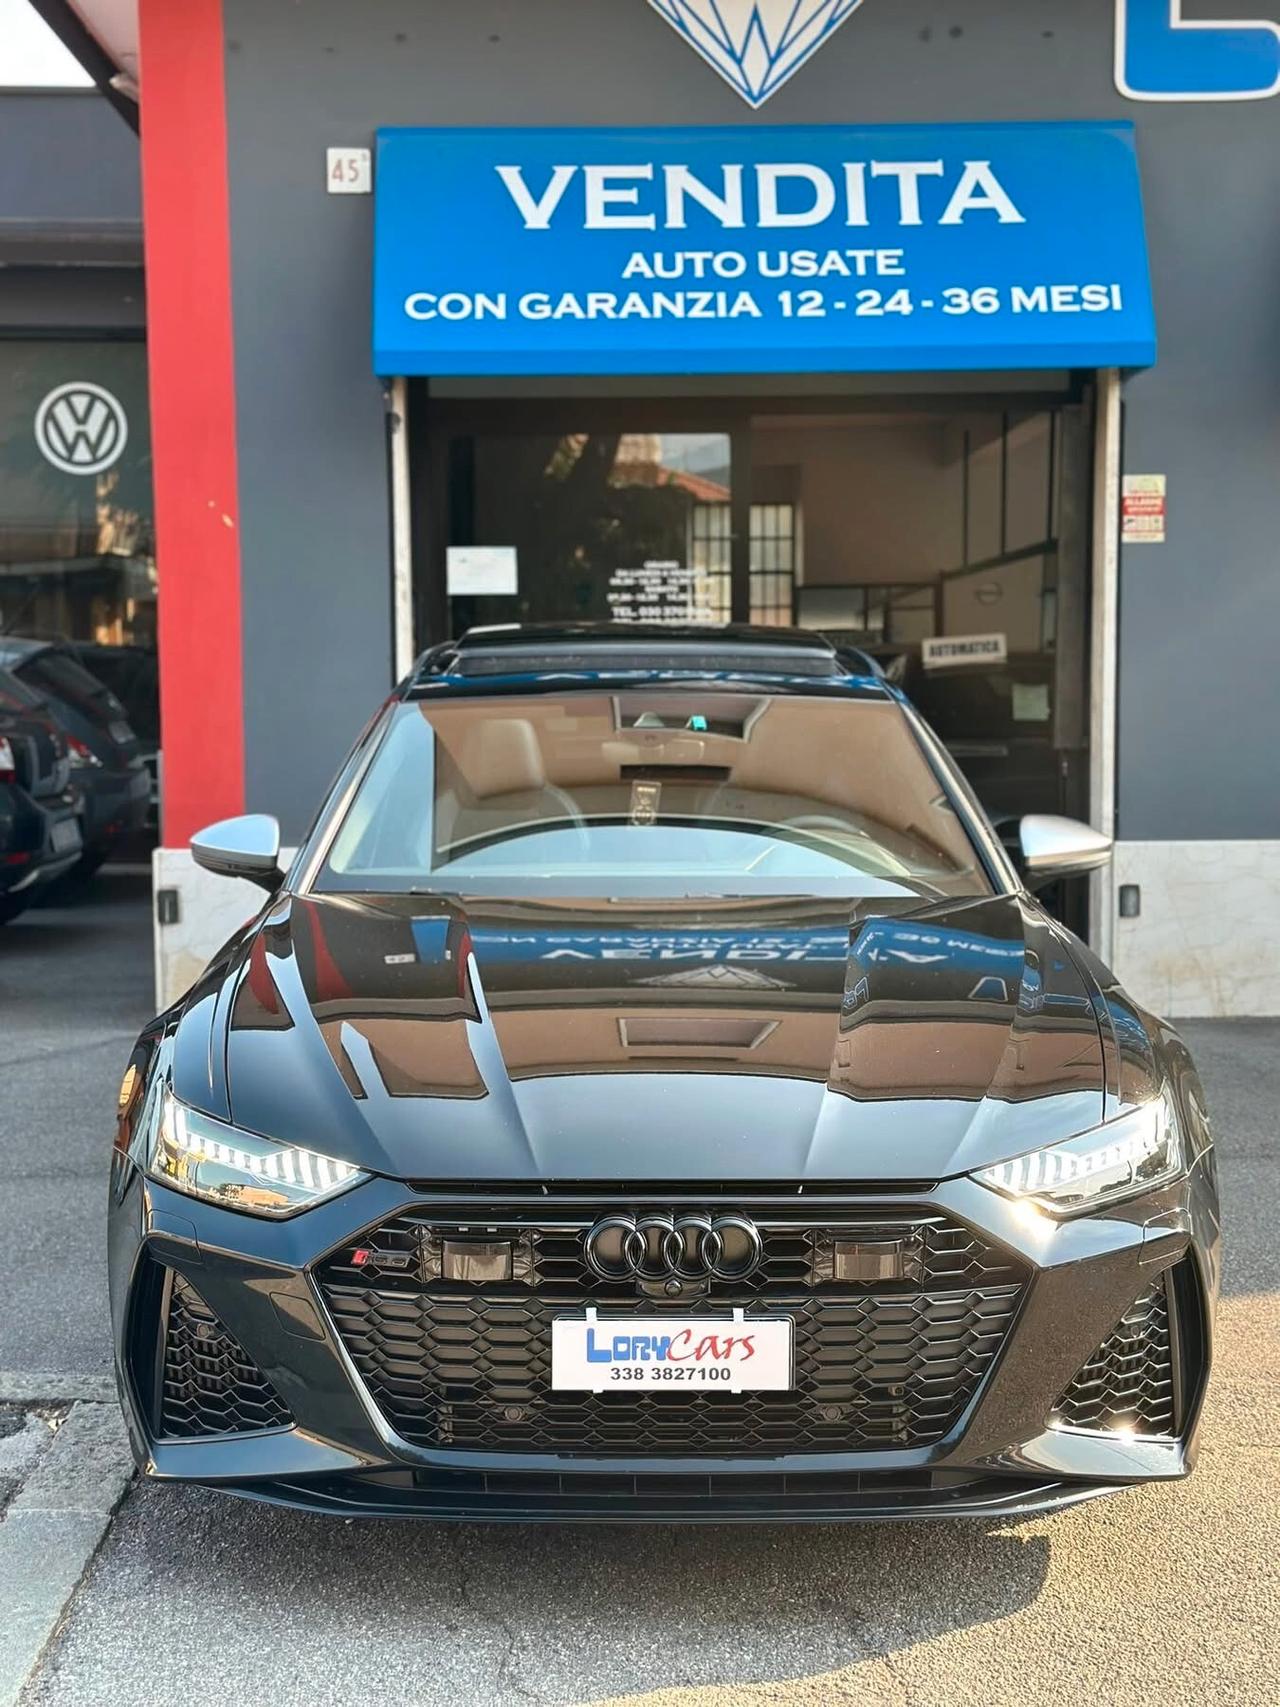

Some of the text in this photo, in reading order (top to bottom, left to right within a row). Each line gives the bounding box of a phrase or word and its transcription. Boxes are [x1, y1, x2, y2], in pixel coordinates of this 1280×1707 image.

[496, 160, 1026, 230] VENDITA
[622, 249, 905, 279] AUTO USATE
[404, 293, 506, 320] CON
[518, 291, 762, 320] GARANZIA
[779, 290, 826, 317] 12
[856, 289, 913, 316] 24
[943, 287, 1000, 314] 36
[1011, 284, 1122, 313] MESI
[610, 1367, 731, 1381] 338 3827100
